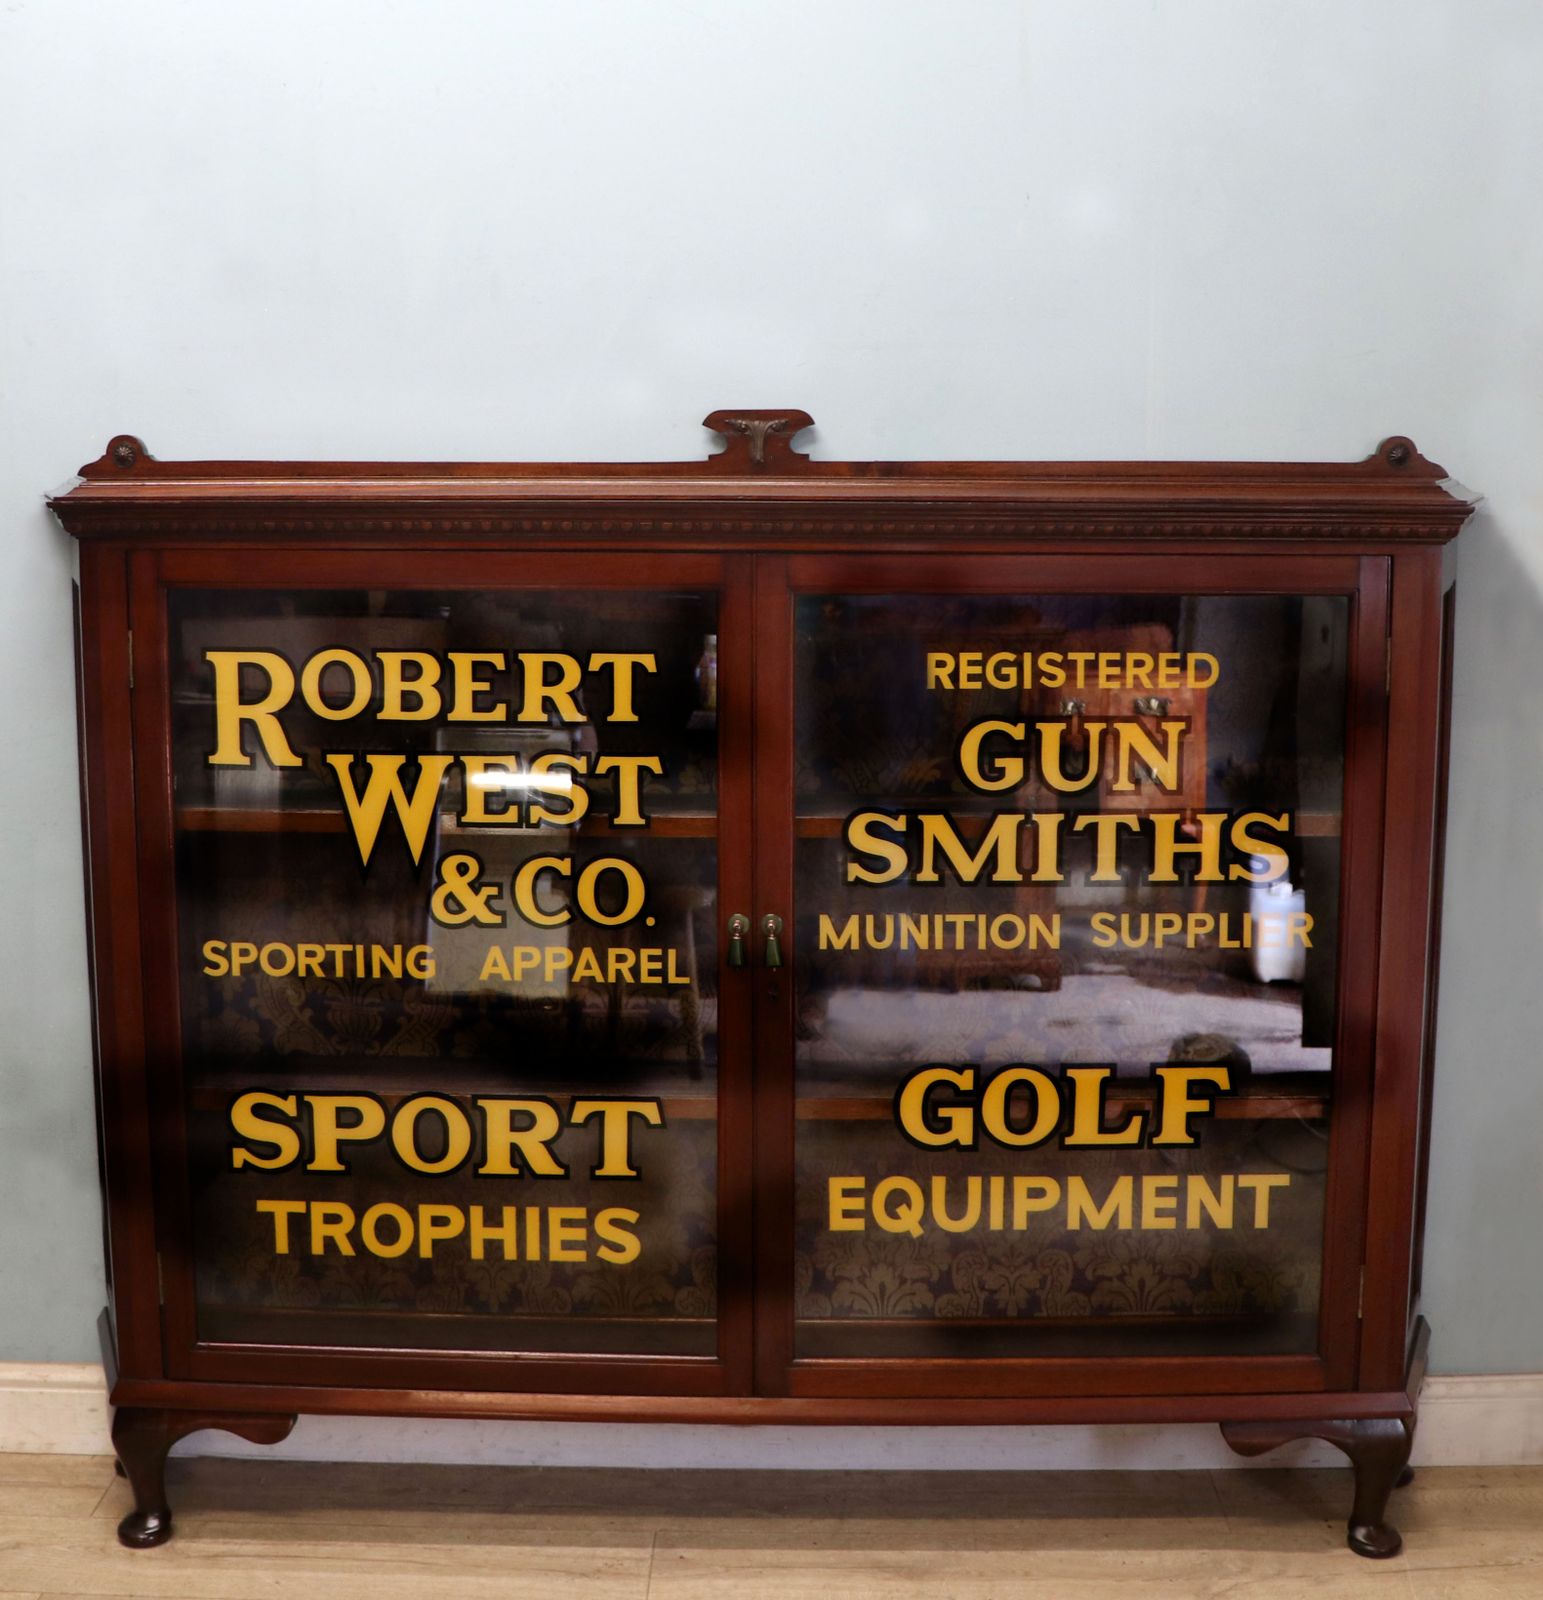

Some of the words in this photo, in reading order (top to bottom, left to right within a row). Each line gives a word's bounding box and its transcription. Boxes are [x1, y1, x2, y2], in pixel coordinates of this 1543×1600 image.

[926, 651, 1220, 690] REGISTERED
[205, 648, 658, 767] ROBERT
[959, 720, 1187, 792] GUN
[326, 754, 663, 866] WEST
[846, 812, 1290, 884] SMITHS
[202, 940, 437, 979] SPORTING
[479, 946, 691, 985] APPAREL
[819, 913, 1061, 951] MUNITION
[1091, 911, 1314, 950] SUPPLIER
[231, 1092, 663, 1177] SPORT
[899, 1067, 1232, 1146] GOLF
[256, 1199, 642, 1265] TROPHIES
[827, 1173, 1291, 1239] EQUIPMENT
